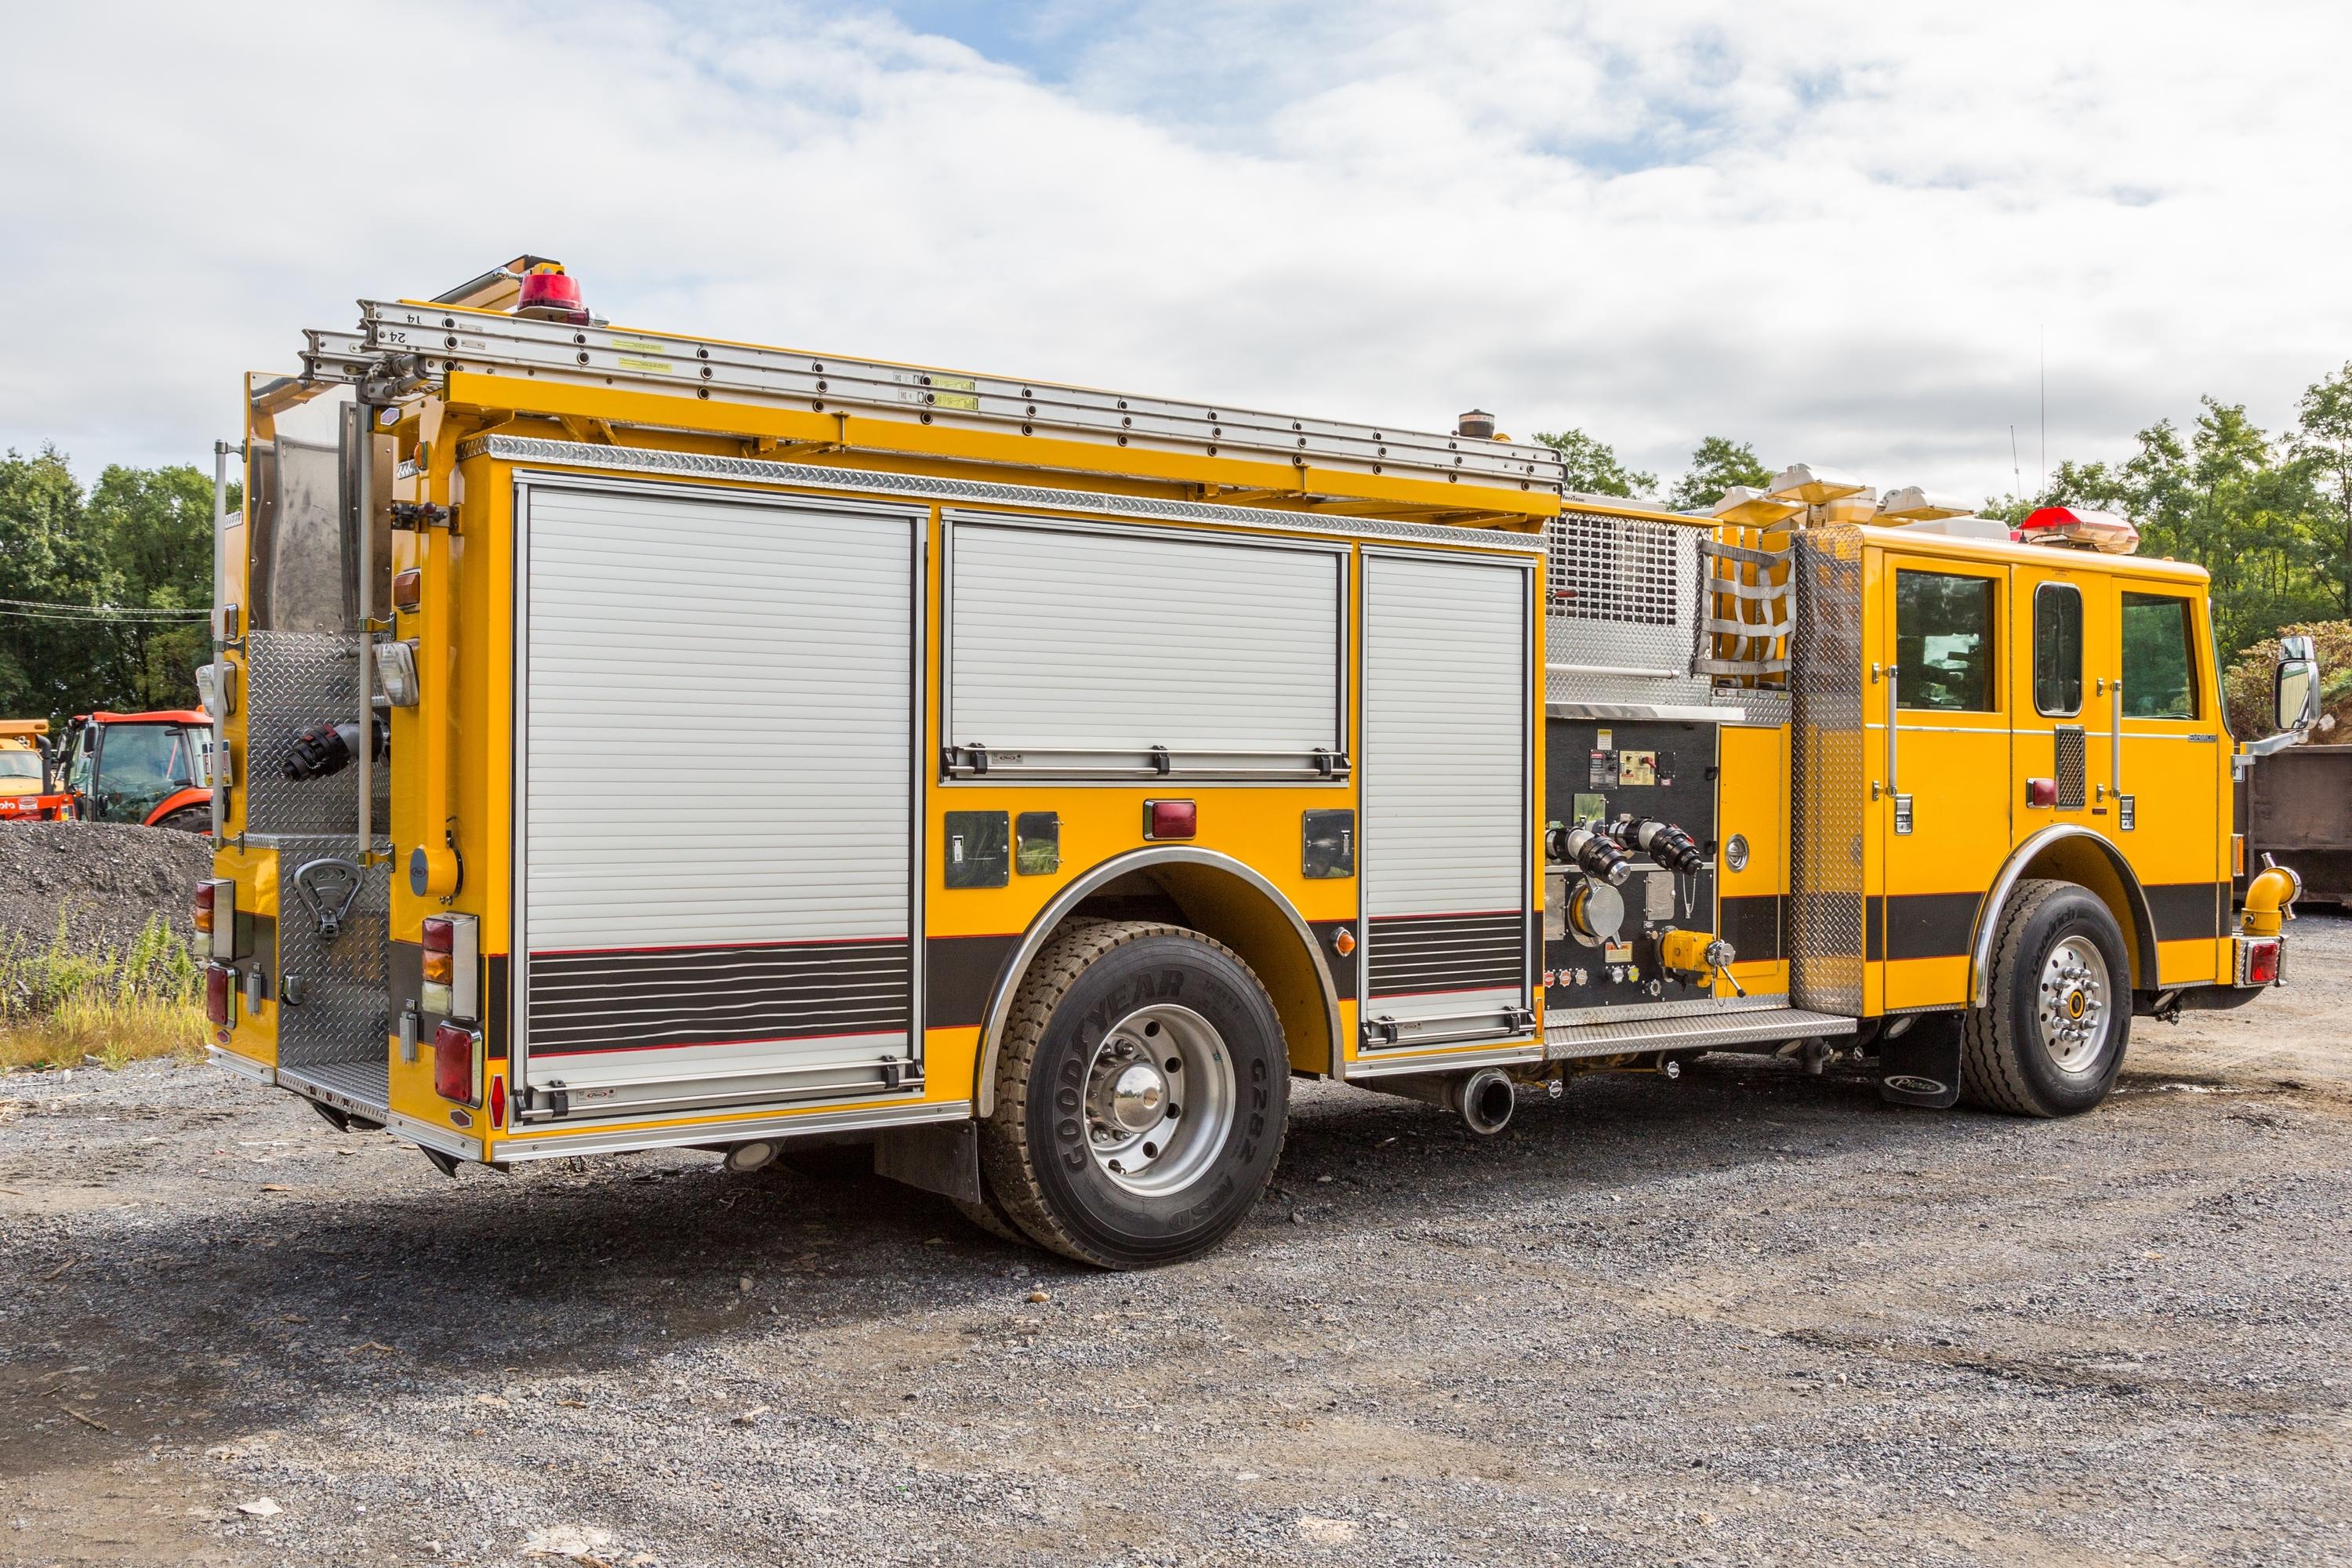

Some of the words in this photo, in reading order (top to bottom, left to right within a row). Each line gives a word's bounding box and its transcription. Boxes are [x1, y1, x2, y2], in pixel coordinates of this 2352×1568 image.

[406, 314, 422, 325] 14
[390, 331, 406, 344] 24
[1240, 1058, 1268, 1165] G282
